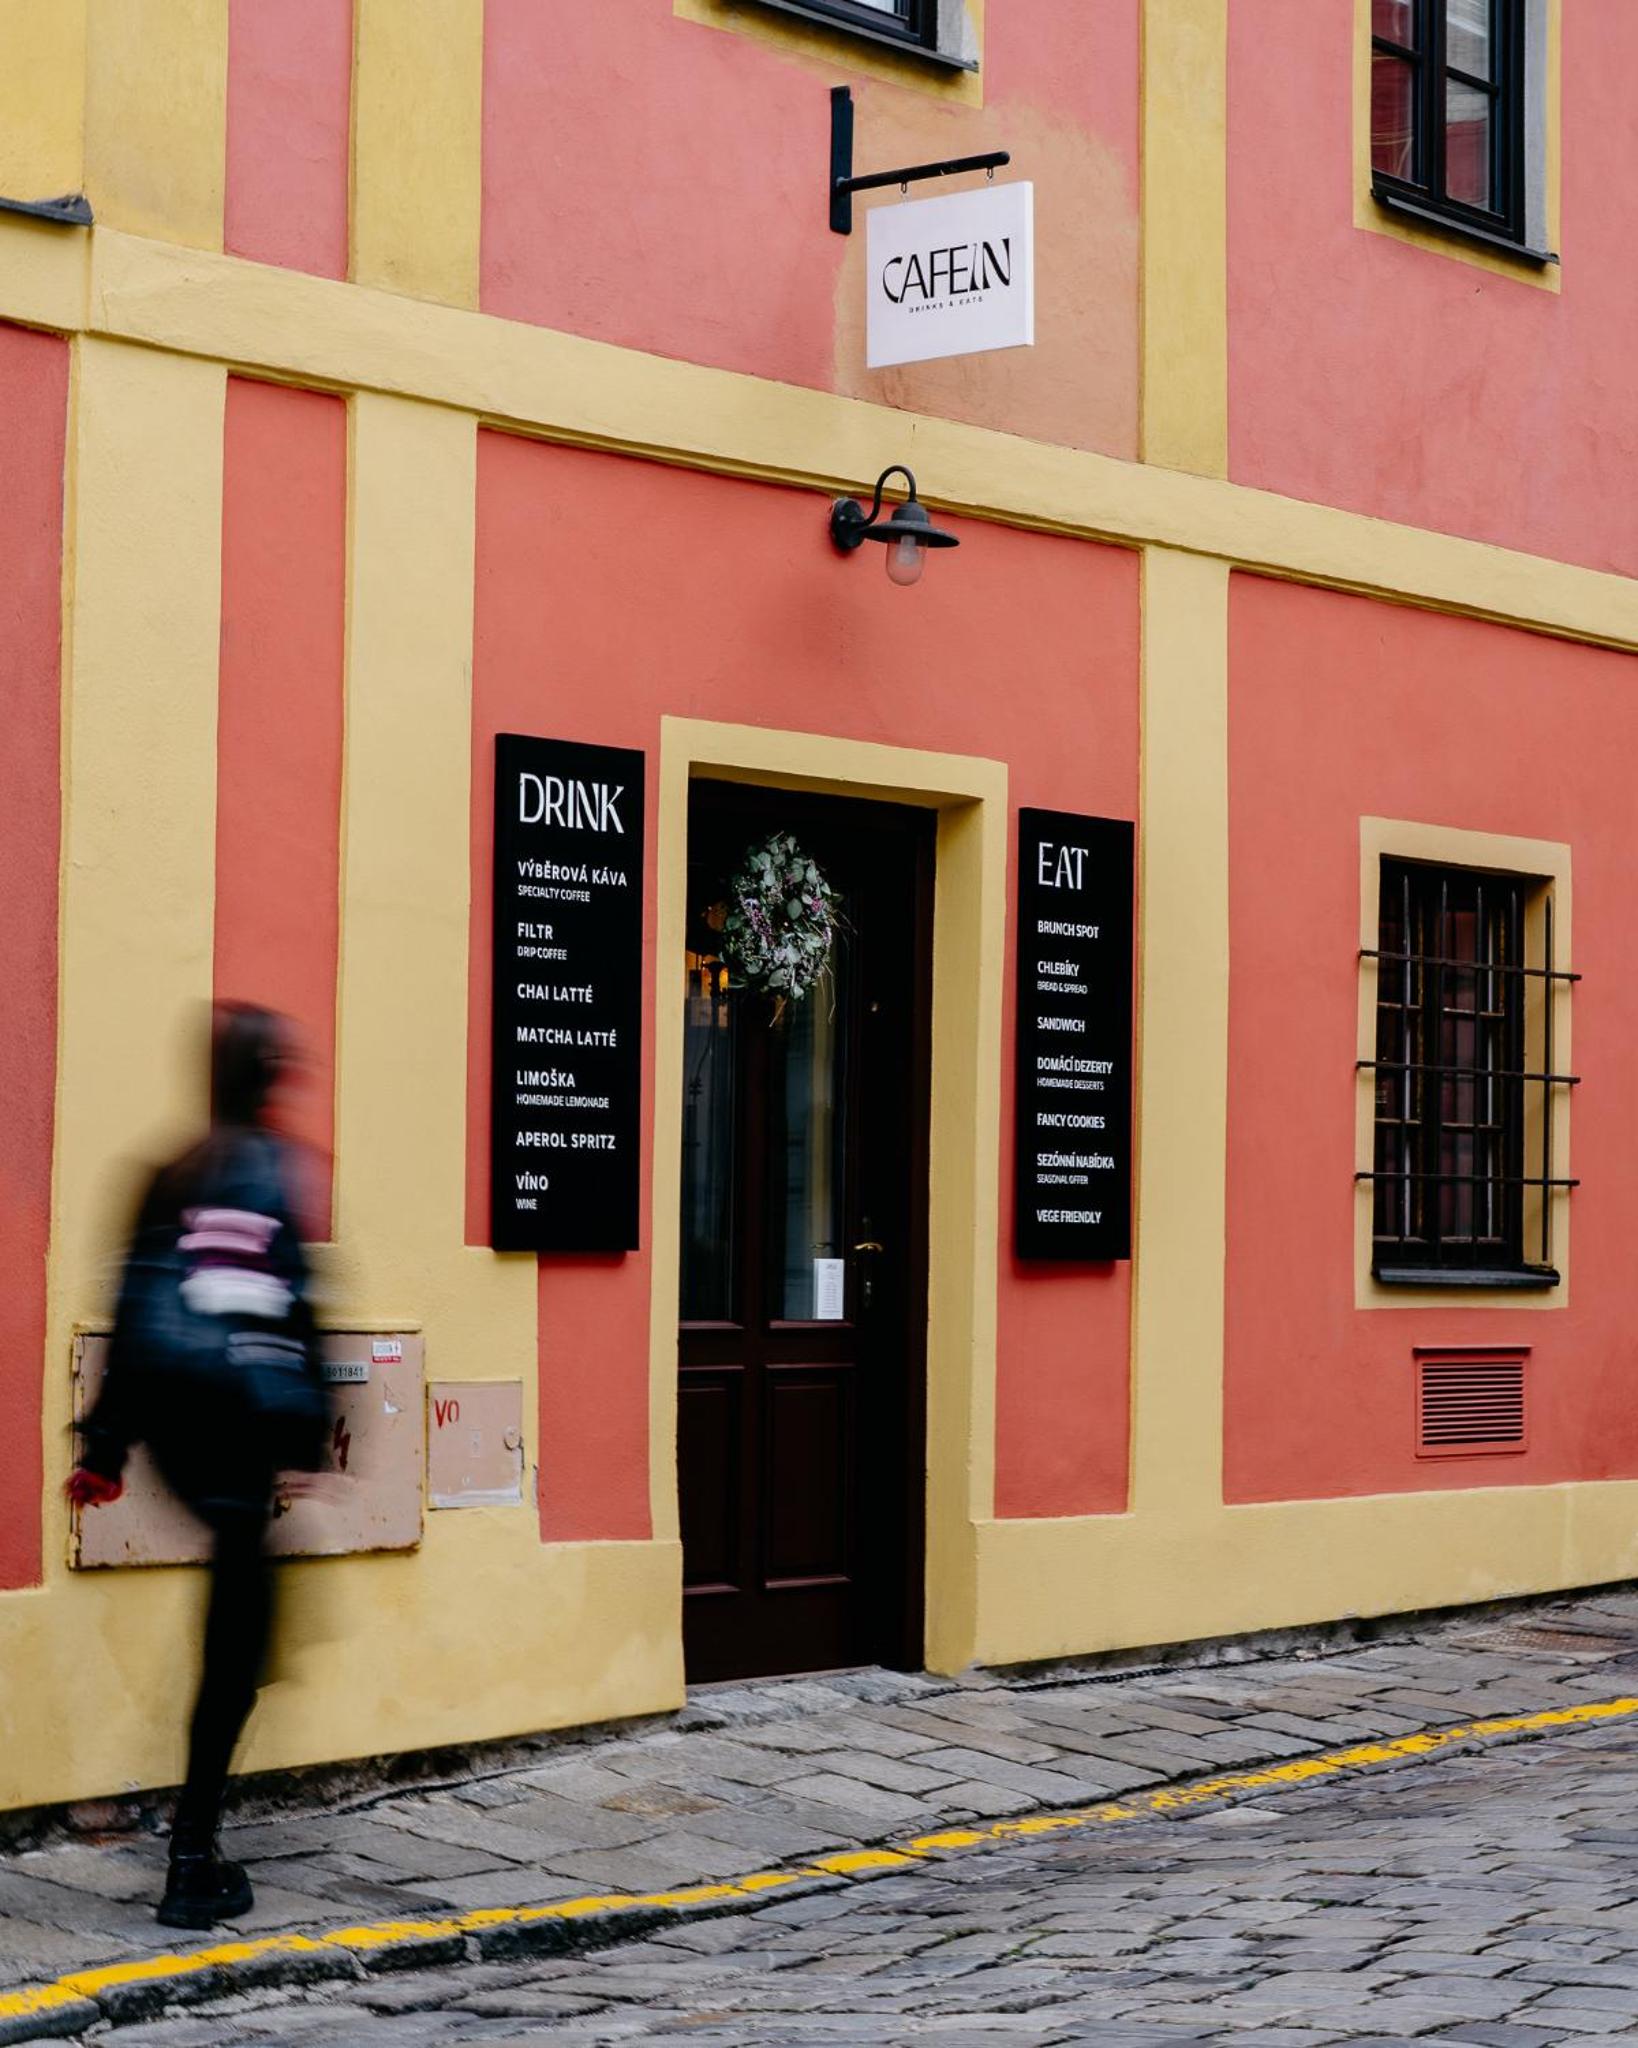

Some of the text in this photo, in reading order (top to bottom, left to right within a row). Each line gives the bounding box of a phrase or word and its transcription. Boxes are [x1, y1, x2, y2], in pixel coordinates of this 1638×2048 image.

[883, 238, 1010, 305] CAFEIN
[958, 296, 983, 306] EATS
[520, 773, 624, 833] DRINK
[518, 859, 627, 886] VÝBĚROVÁ KÁVA
[1039, 842, 1088, 889] EAT
[518, 885, 590, 902] SPECIALTY COFFEE
[518, 922, 552, 939] FILTR
[1038, 920, 1099, 938] BRUNCH SPOT
[517, 946, 567, 960] DRIP COFFEE
[1038, 960, 1079, 976] CHLEBÍKY
[517, 984, 592, 1003] CHAI LATTÉ
[1037, 981, 1058, 991] BREAD
[1064, 983, 1089, 994] SPREAD
[1038, 1017, 1085, 1032] SANDWICH
[517, 1027, 616, 1047] MATCHA LATTÉ
[1037, 1055, 1113, 1074] DOMÁCÍ DEZERTY
[517, 1068, 575, 1087] LIMOŠKA
[1037, 1077, 1104, 1090] HOMEMADE DESSERTS
[517, 1094, 609, 1108] HOMEMADE LEMONADE
[1037, 1113, 1105, 1128] FANCY COOKIES
[516, 1132, 615, 1149] APEROL SPRITZ
[1037, 1151, 1114, 1168] SEZÓNNÍ NABÍDKA
[516, 1171, 548, 1190] VÍNO
[516, 1198, 537, 1210] WINE
[1037, 1210, 1101, 1223] VEGE FRIENDLY
